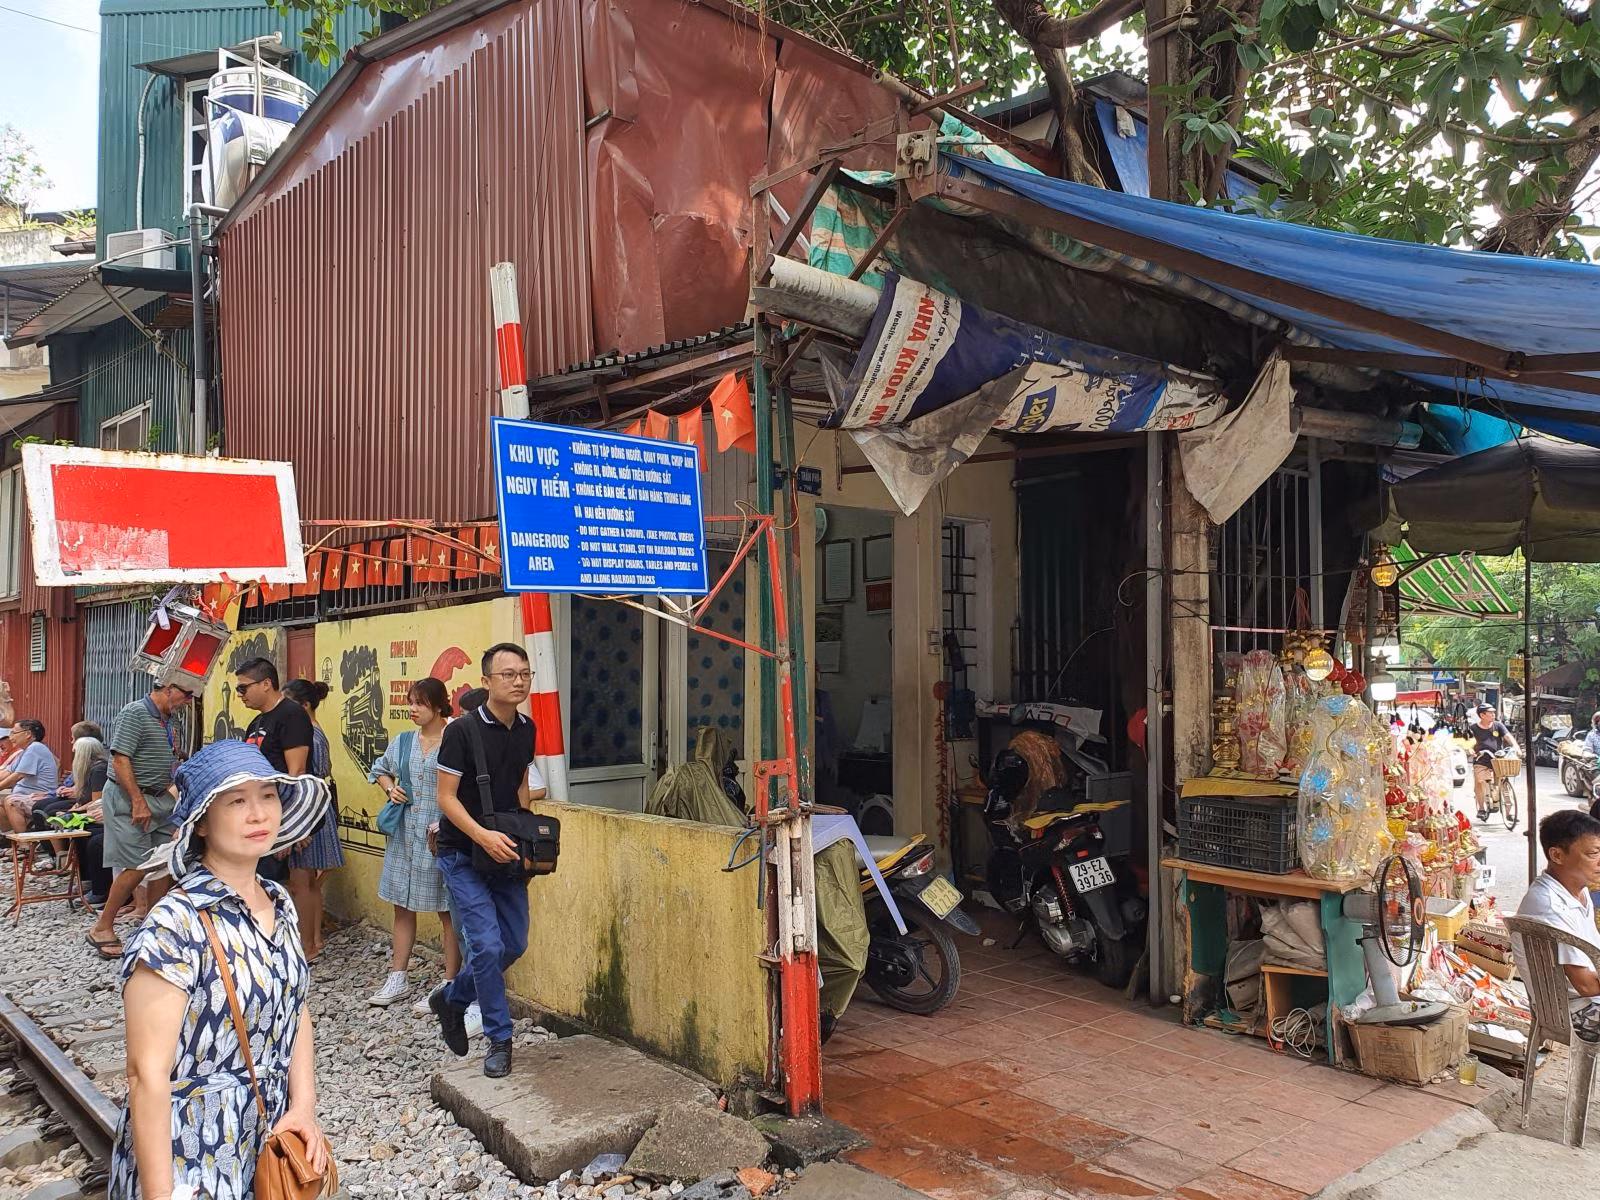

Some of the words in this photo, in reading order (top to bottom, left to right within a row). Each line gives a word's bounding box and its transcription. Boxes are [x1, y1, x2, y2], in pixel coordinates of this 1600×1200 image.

[907, 296, 935, 342] NHA
[880, 347, 919, 400] KHOA
[509, 443, 534, 464] KHU
[536, 446, 560, 470] VỰC
[506, 475, 538, 496] NGUY
[541, 472, 570, 498] HIỂM
[511, 531, 570, 549] DANGEROUS
[579, 525, 588, 536] DO
[587, 525, 600, 537] NOT
[599, 526, 620, 538] GATHER
[646, 529, 659, 540] TAKE
[580, 541, 590, 552] DO
[589, 541, 601, 553] NOT
[528, 556, 555, 571] AREA
[580, 557, 591, 568] DO
[590, 557, 602, 568] NOT
[602, 558, 624, 569] DISPLAY
[645, 560, 664, 571] TABLES
[663, 560, 674, 571] AND
[580, 573, 593, 584] AND
[592, 573, 611, 585] ALONG
[636, 575, 656, 585] TRACKS
[401, 661, 407, 676] TO
[1075, 859, 1104, 877] 29-E2
[1077, 870, 1112, 890] 392.36
